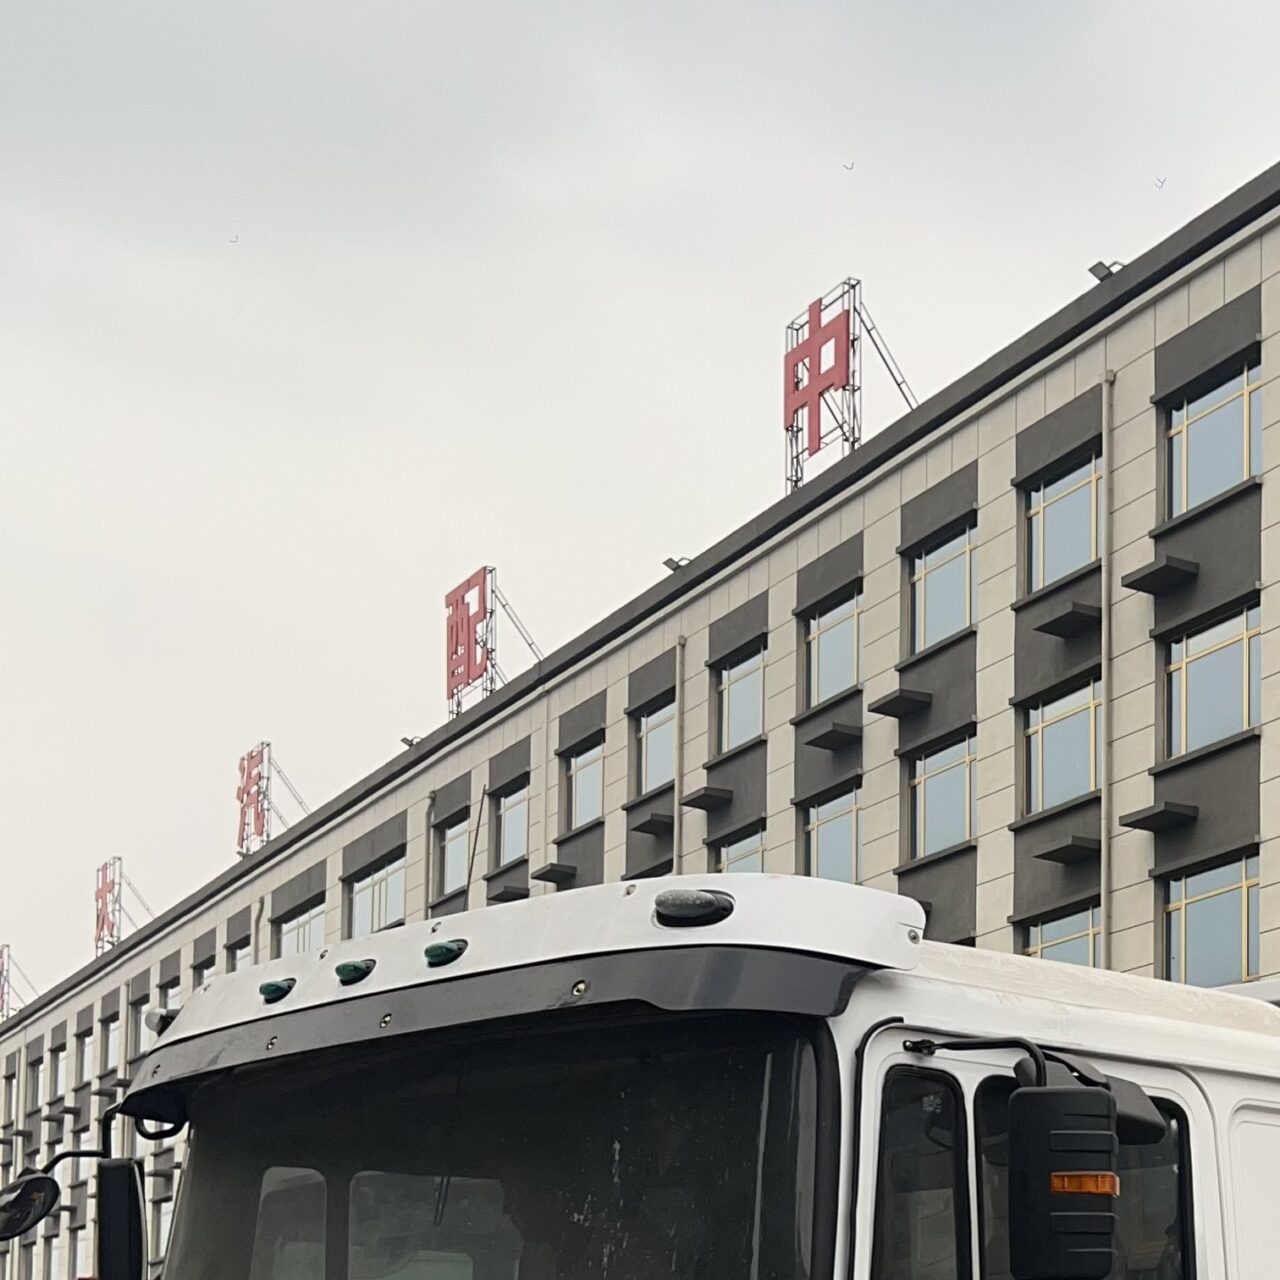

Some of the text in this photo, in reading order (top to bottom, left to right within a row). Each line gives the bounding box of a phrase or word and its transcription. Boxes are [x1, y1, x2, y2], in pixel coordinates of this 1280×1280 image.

[237, 749, 264, 848] 汽
[445, 565, 487, 700] 配
[784, 297, 850, 456] 中
